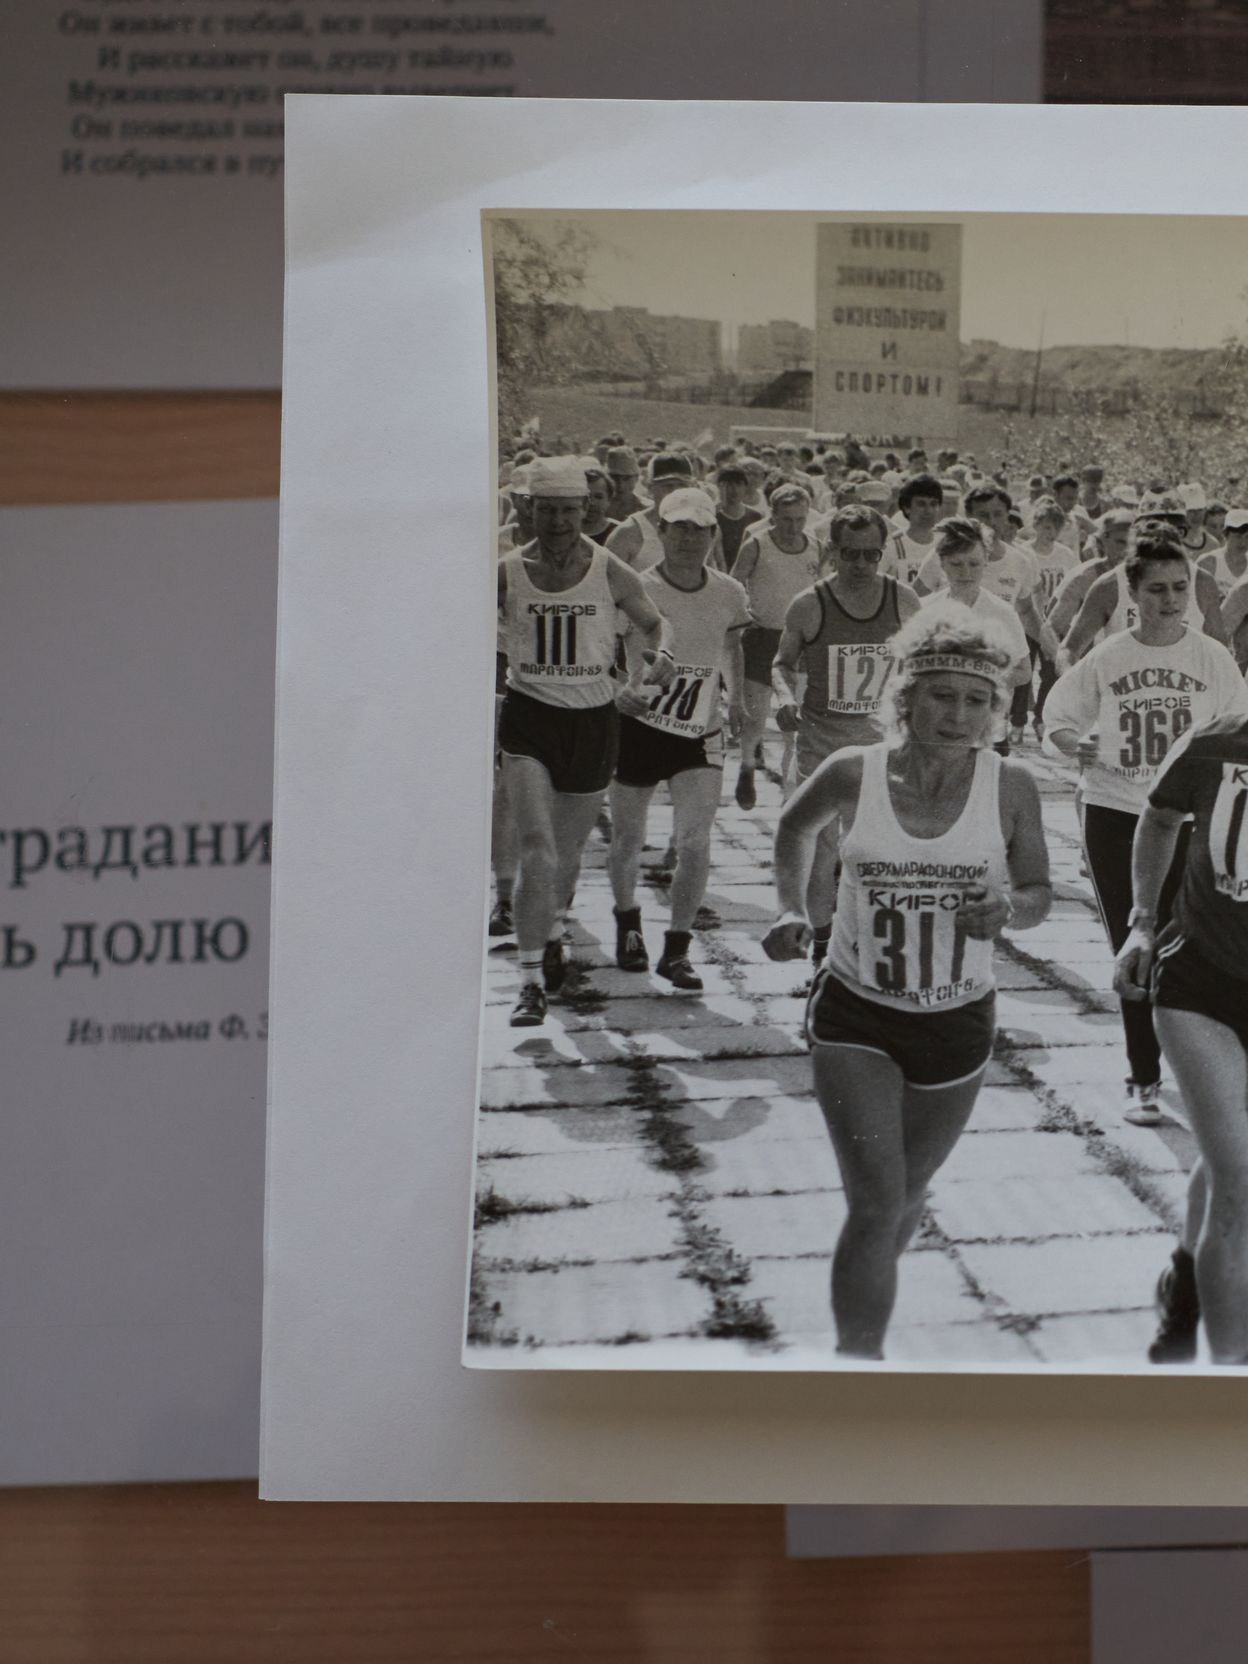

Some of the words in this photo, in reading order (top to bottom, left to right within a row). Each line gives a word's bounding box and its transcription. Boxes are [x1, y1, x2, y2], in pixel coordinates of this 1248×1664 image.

[881, 341, 897, 361] И
[528, 604, 597, 616] КИРОВ
[537, 615, 577, 666] 111
[838, 645, 891, 656] КИРО
[1118, 696, 1193, 712] КИРОВ
[0, 821, 272, 889] радани
[53, 916, 250, 979] долю
[873, 908, 967, 991] 311
[67, 1017, 104, 1046] Из
[111, 1019, 211, 1044] письма
[218, 1012, 249, 1041] Ф.
